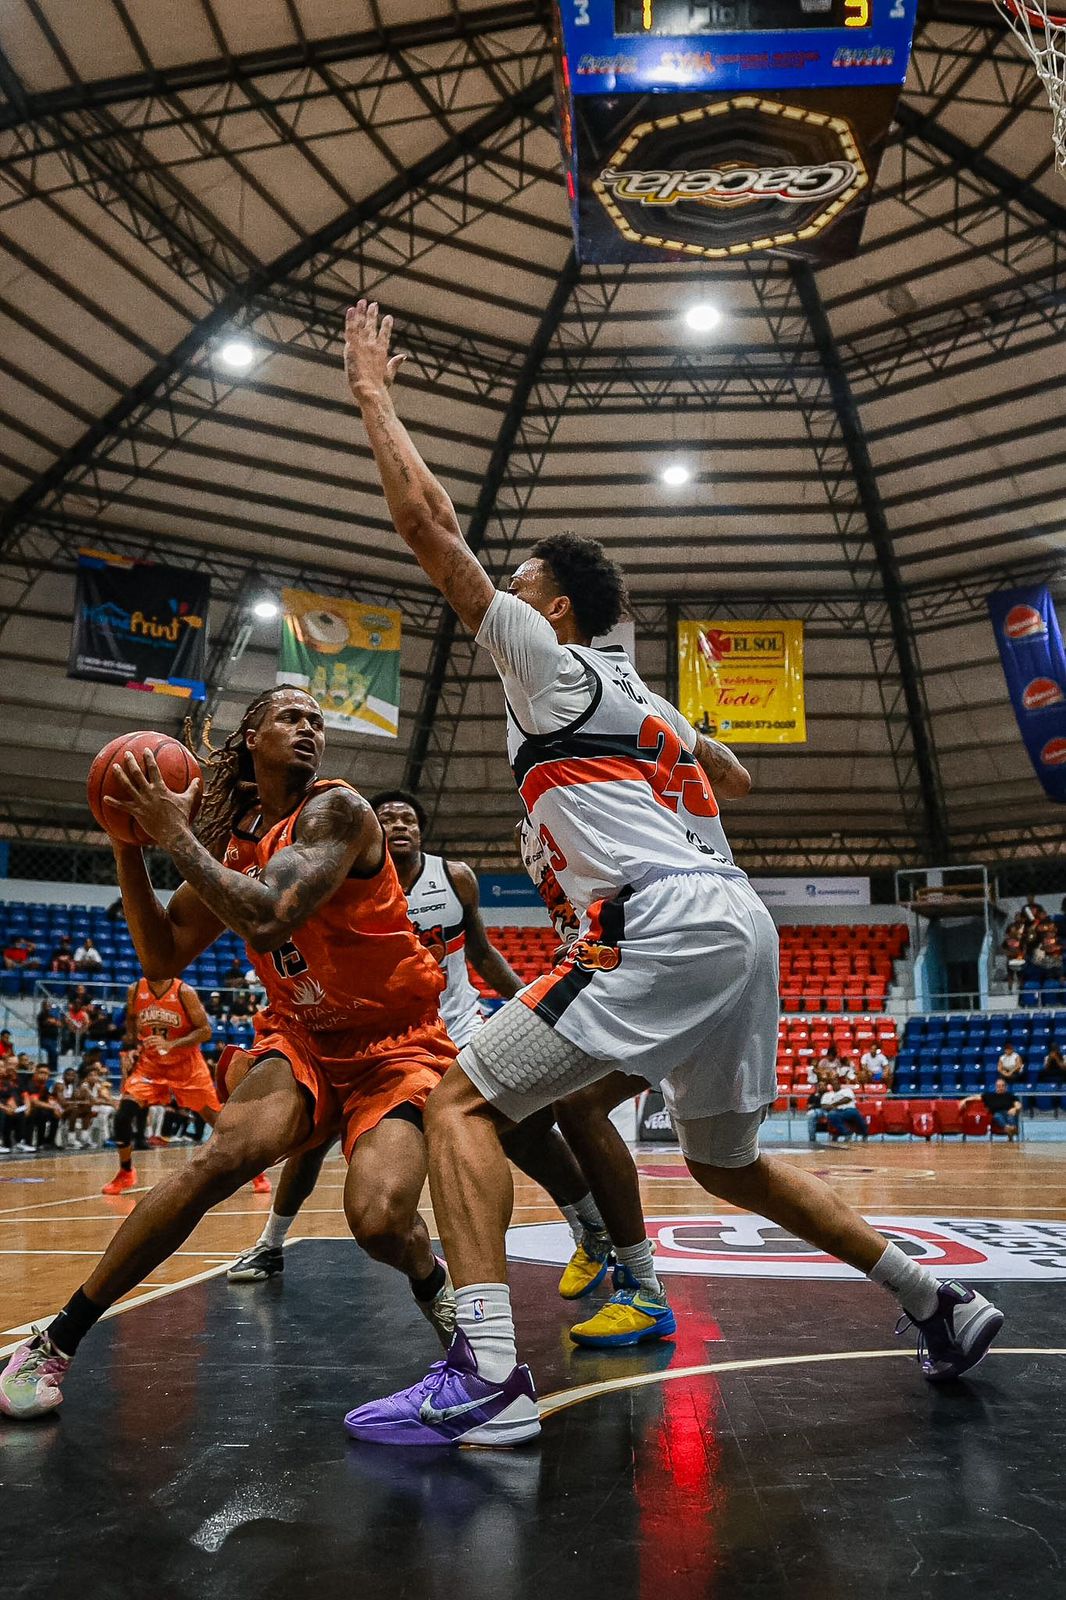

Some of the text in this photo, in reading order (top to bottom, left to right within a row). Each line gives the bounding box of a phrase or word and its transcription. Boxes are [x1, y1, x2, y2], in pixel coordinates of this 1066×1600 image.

[600, 162, 856, 205] Gacela
[733, 637, 780, 652] EL SOL
[419, 903, 447, 913] SPORT
